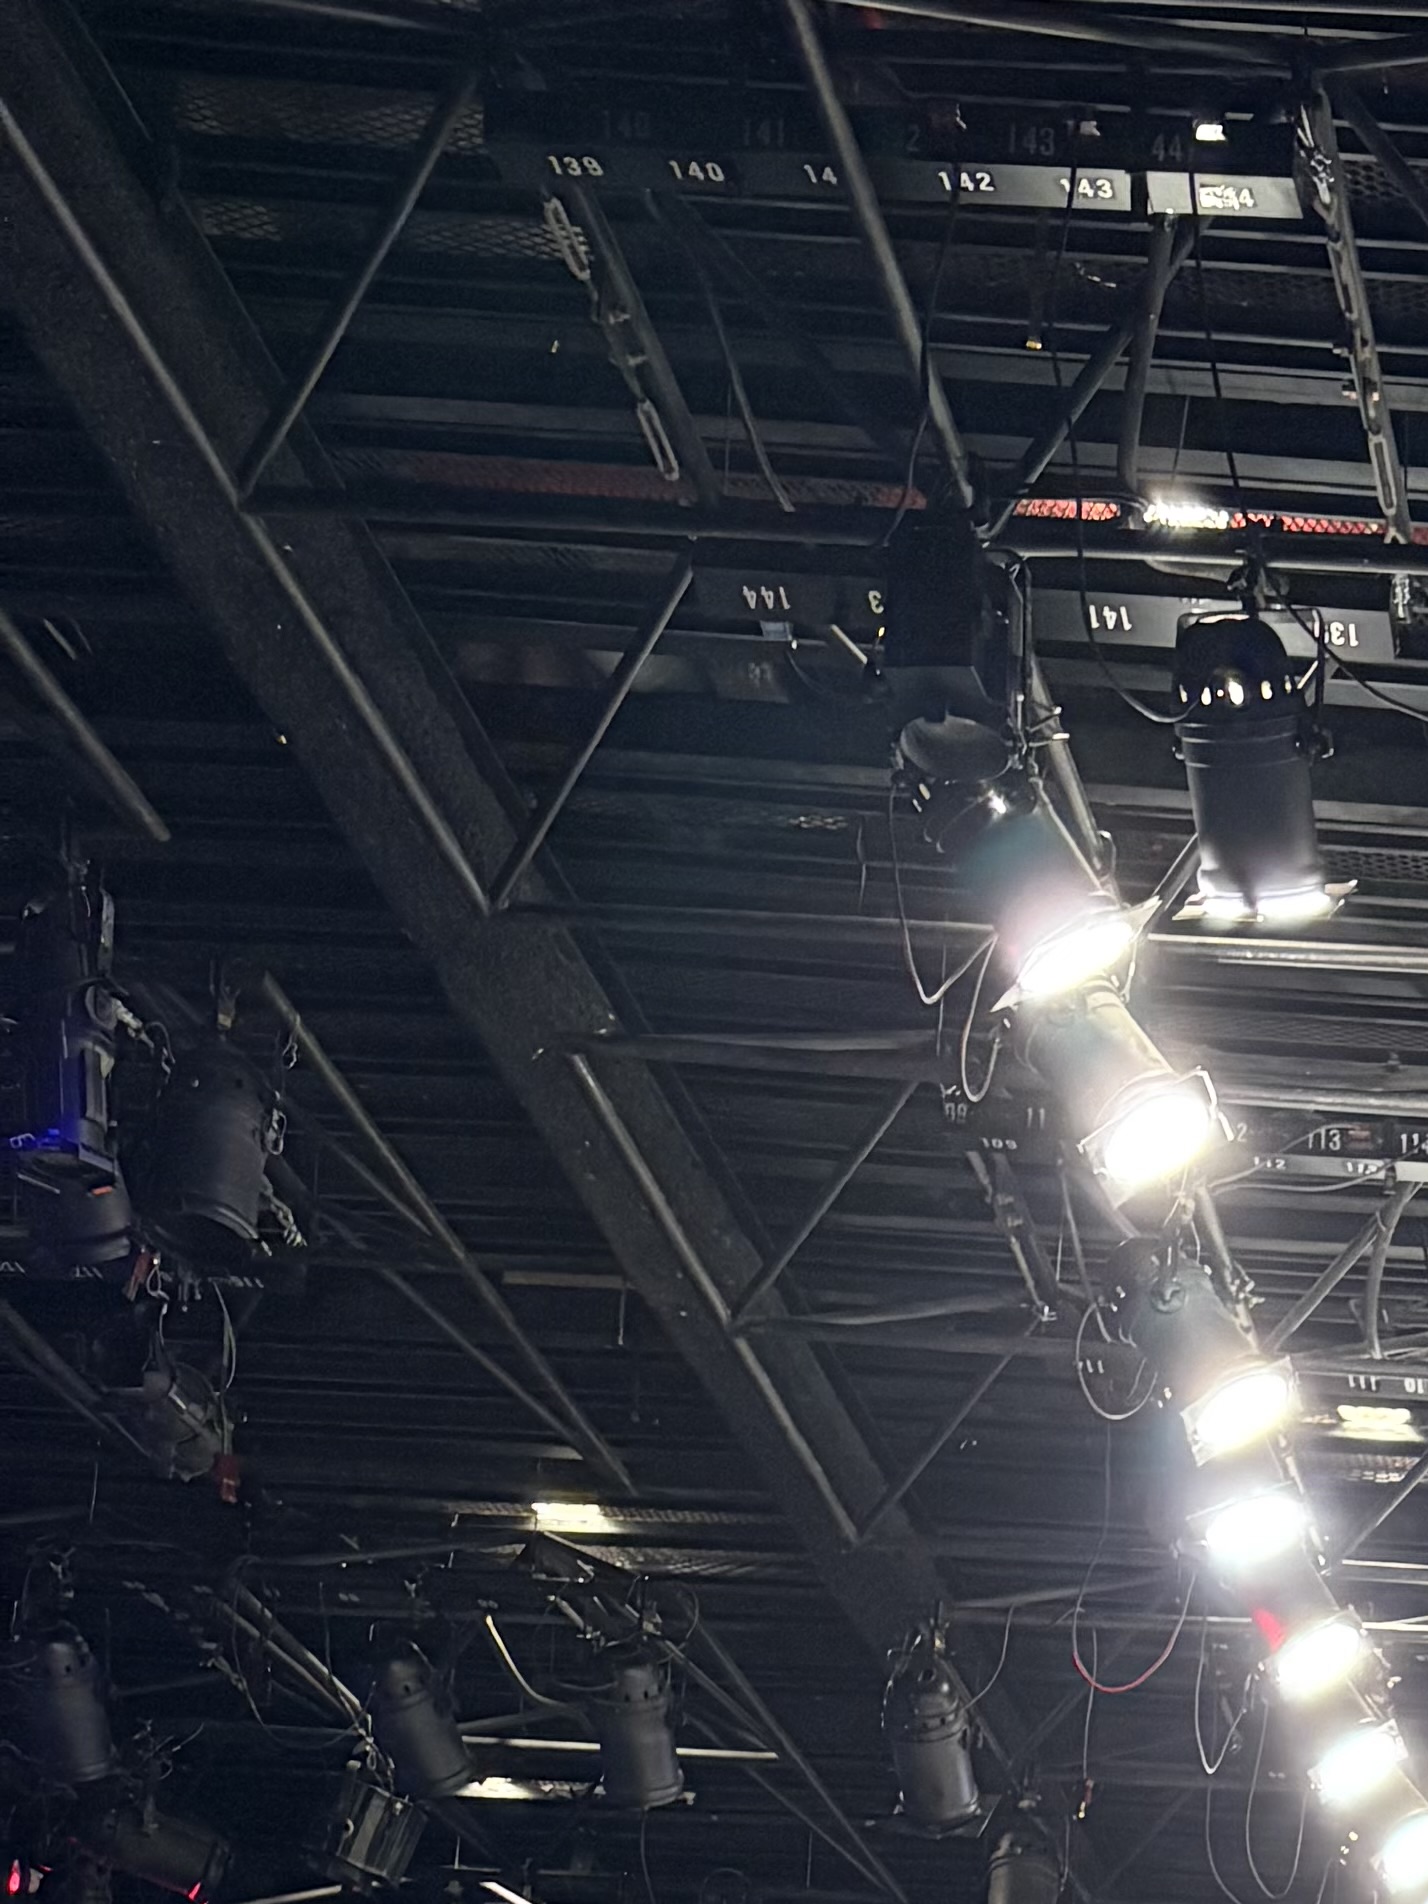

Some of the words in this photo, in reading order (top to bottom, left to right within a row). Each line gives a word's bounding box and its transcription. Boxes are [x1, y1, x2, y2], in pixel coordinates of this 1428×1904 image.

[668, 159, 726, 183] 140
[803, 162, 839, 187] 14
[937, 169, 996, 193] 142
[1060, 177, 1114, 200] 143
[1325, 620, 1360, 648] 13
